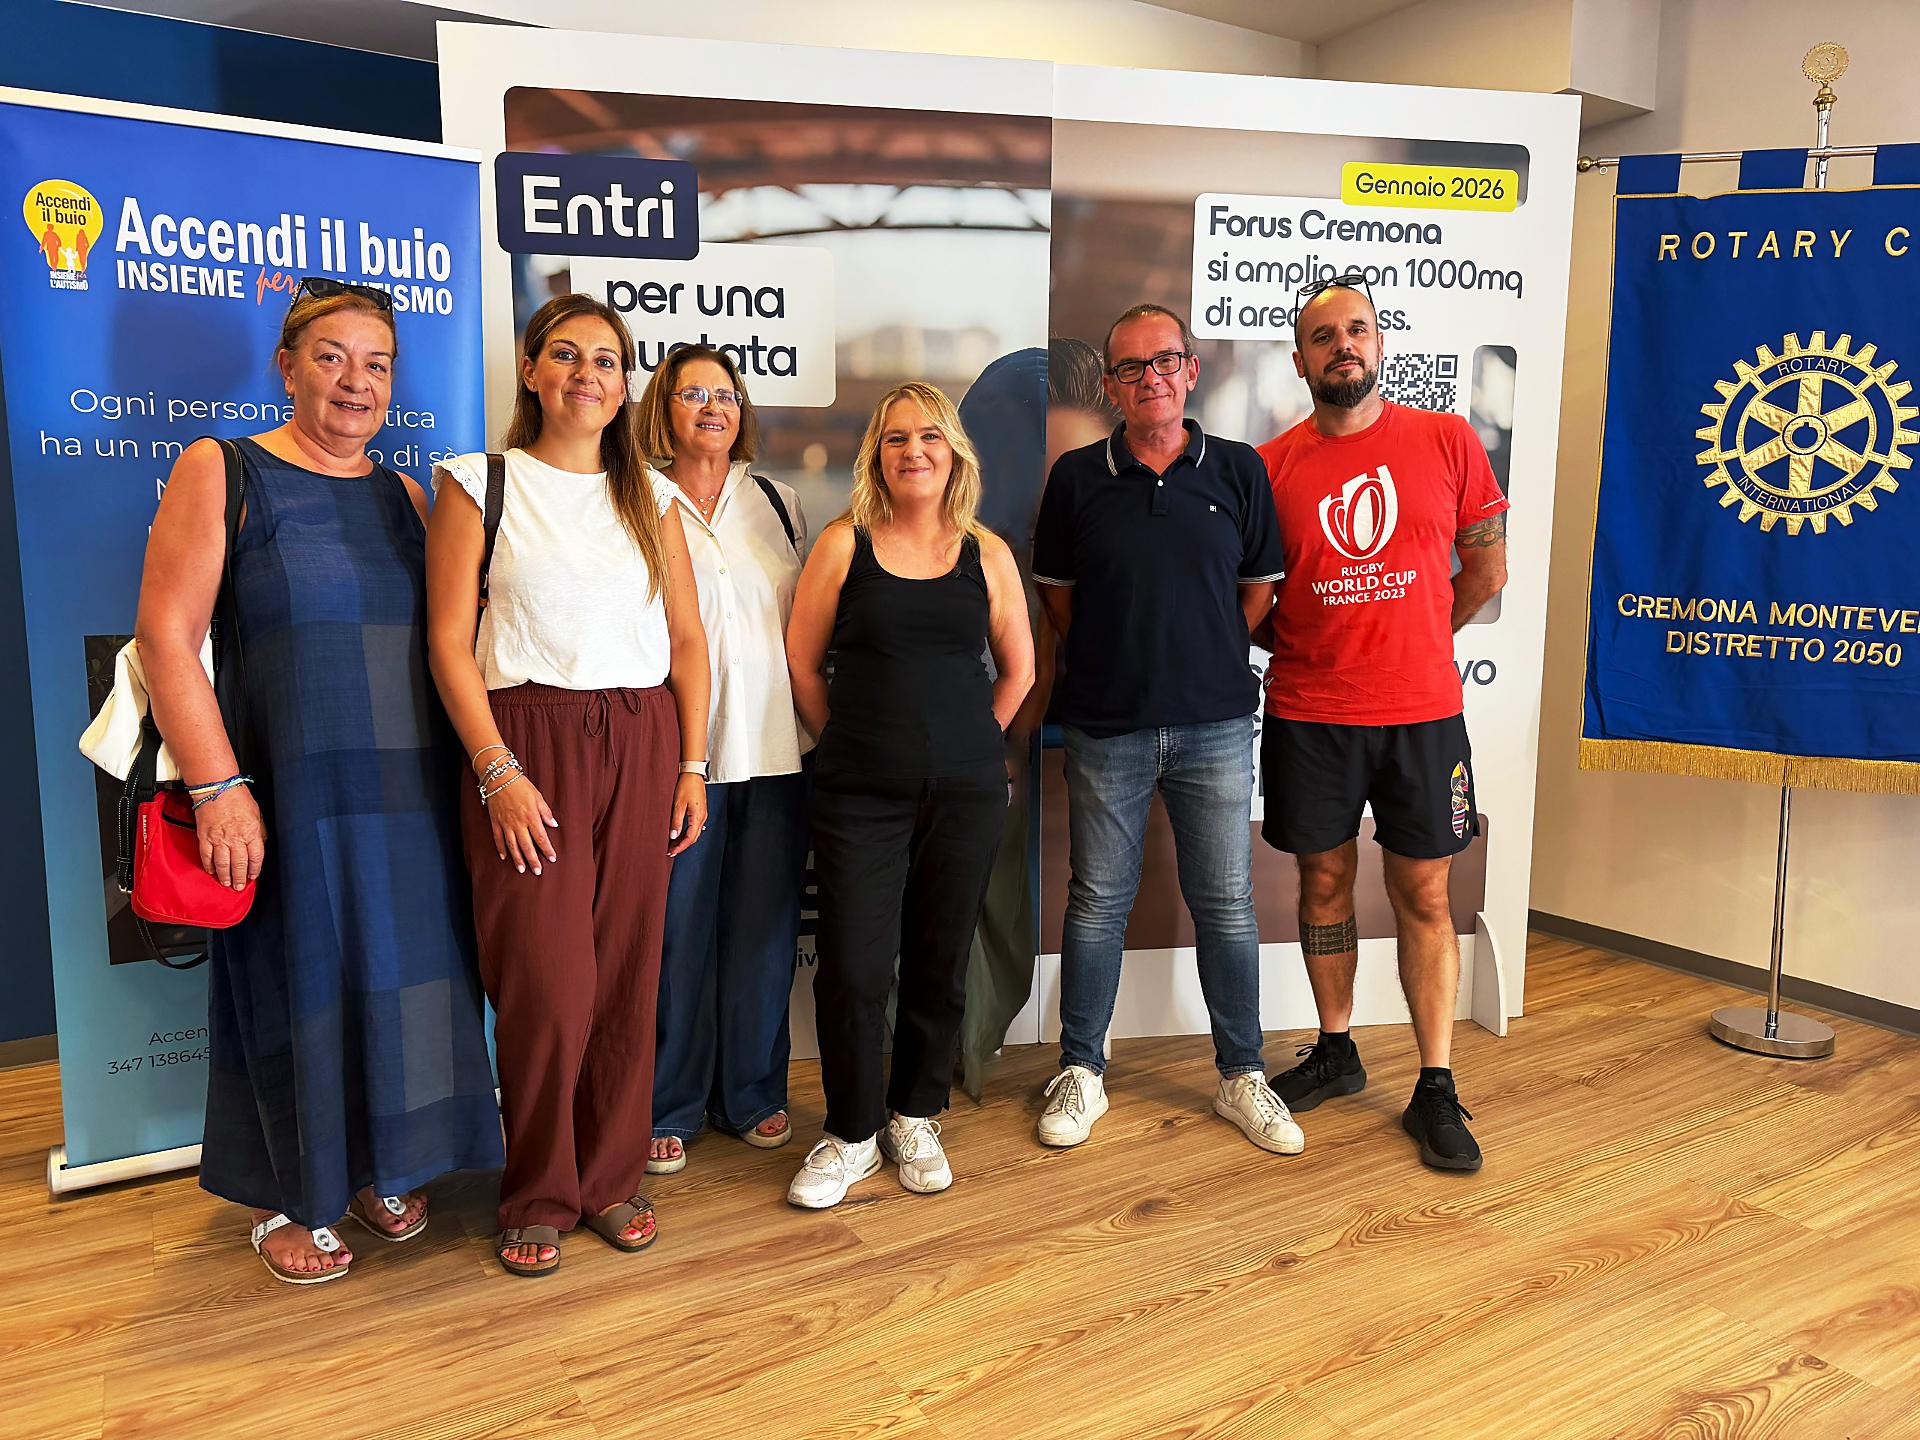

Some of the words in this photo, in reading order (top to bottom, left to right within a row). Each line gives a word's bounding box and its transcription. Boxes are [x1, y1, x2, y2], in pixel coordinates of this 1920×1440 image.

[1355, 172, 1446, 198] Gennaio
[1451, 177, 1505, 200] 2026
[36, 192, 90, 212] Accendi
[42, 208, 51, 222] il
[55, 209, 86, 225] buio
[522, 175, 675, 239] Entri
[116, 197, 306, 270] Accendi
[322, 217, 347, 272] il
[361, 222, 452, 282] buio
[1209, 205, 1292, 239] Forus
[1300, 210, 1442, 245] Cremona
[1657, 230, 1853, 261] ROTARY
[117, 260, 245, 299] INSIEME
[256, 266, 299, 306] per
[1207, 251, 1228, 282] si
[1405, 258, 1523, 299] 1000mq
[606, 280, 684, 315] per
[696, 284, 785, 318] una
[1205, 296, 1232, 327] di
[1777, 357, 1851, 377] ROTARY
[70, 389, 155, 422] Ogni
[168, 399, 295, 422] persona
[40, 430, 82, 456] ha
[95, 438, 139, 458] un
[393, 444, 419, 467] di
[1737, 475, 1863, 513] INTERNATIONAL
[1312, 575, 1379, 595] WORLD
[1382, 570, 1417, 587] CUP
[1341, 561, 1385, 577] RUGBY
[1323, 592, 1371, 606] FRANCE
[1373, 587, 1406, 601] 2023
[1617, 593, 1758, 624] CREMONA
[1768, 601, 1920, 634] MONTEVE
[1666, 631, 1825, 662] DISTRETTO
[1833, 640, 1902, 668] 2050
[149, 1028, 208, 1046] Accen
[107, 1057, 143, 1075] 347
[148, 1047, 212, 1068] 138645
